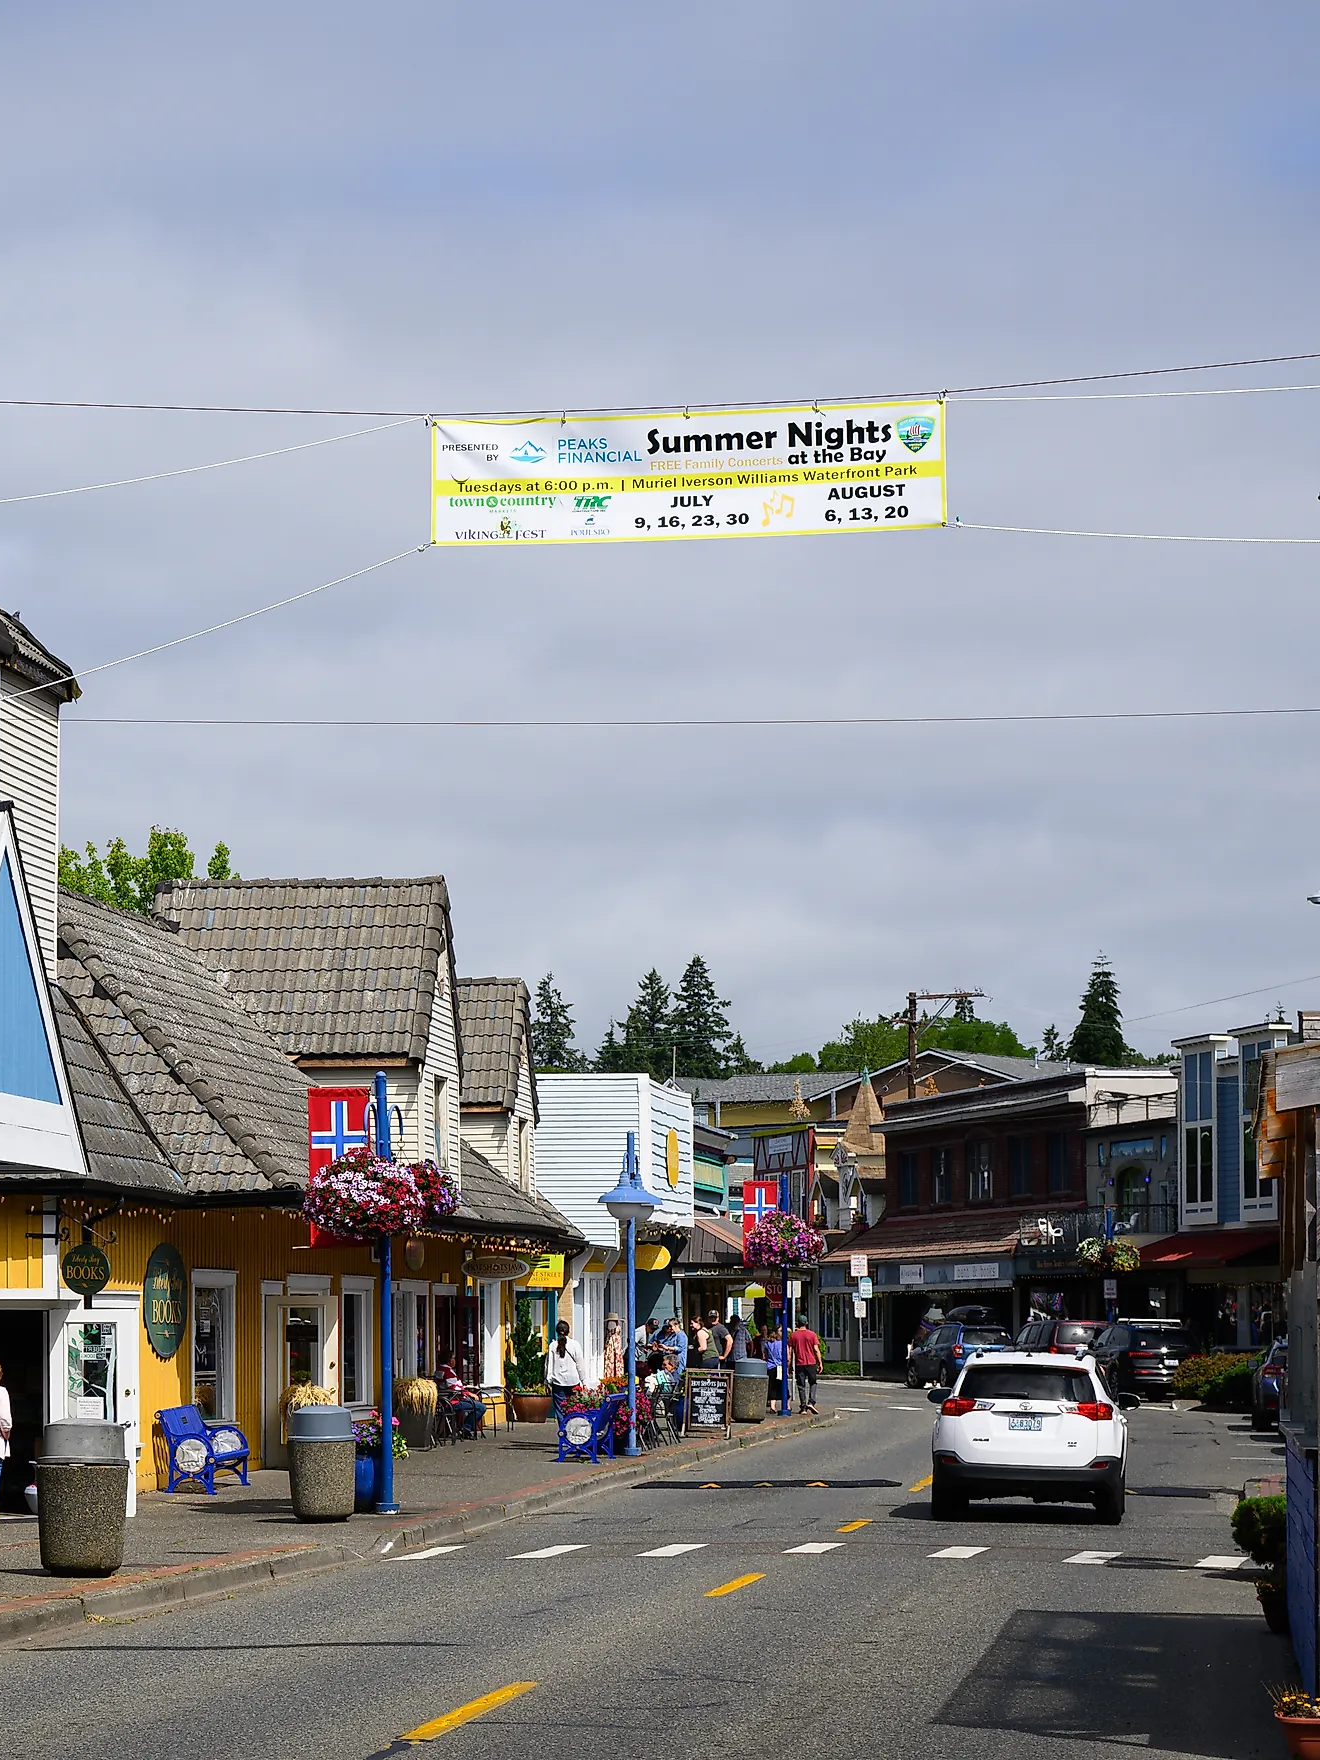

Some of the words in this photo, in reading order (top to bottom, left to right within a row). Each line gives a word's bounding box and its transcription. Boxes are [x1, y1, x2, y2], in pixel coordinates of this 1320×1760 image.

[557, 437, 608, 450] PEAKS
[646, 428, 778, 455] Summer
[787, 419, 892, 450] Nights
[442, 443, 499, 452] PRESENTED
[486, 454, 499, 462] BY
[558, 450, 643, 464] FINANCIAL
[649, 460, 681, 471] FREE
[685, 459, 725, 470] Family
[727, 456, 783, 467] Concerts
[787, 450, 808, 465] at
[813, 448, 844, 464] the
[850, 447, 887, 465] Bay
[458, 482, 522, 495] Tuesdays
[525, 482, 539, 492] at
[544, 481, 578, 491] 6:00
[582, 481, 614, 493] p.m.
[632, 477, 677, 489] Muriel
[682, 476, 733, 487] Iverson
[737, 472, 799, 485] Williams
[803, 467, 883, 482] Waterfront
[884, 465, 918, 476] Park
[827, 484, 906, 500] AUGUST
[670, 495, 714, 508] JULY
[634, 517, 651, 529] 9,
[657, 516, 686, 529] 16,
[691, 514, 720, 528] 23,
[726, 513, 750, 525] 30
[824, 510, 842, 524] 6,
[848, 507, 879, 522] 13,
[884, 505, 909, 519] 20
[65, 1265, 105, 1281] BOOKS
[151, 1299, 182, 1324] BOOKS
